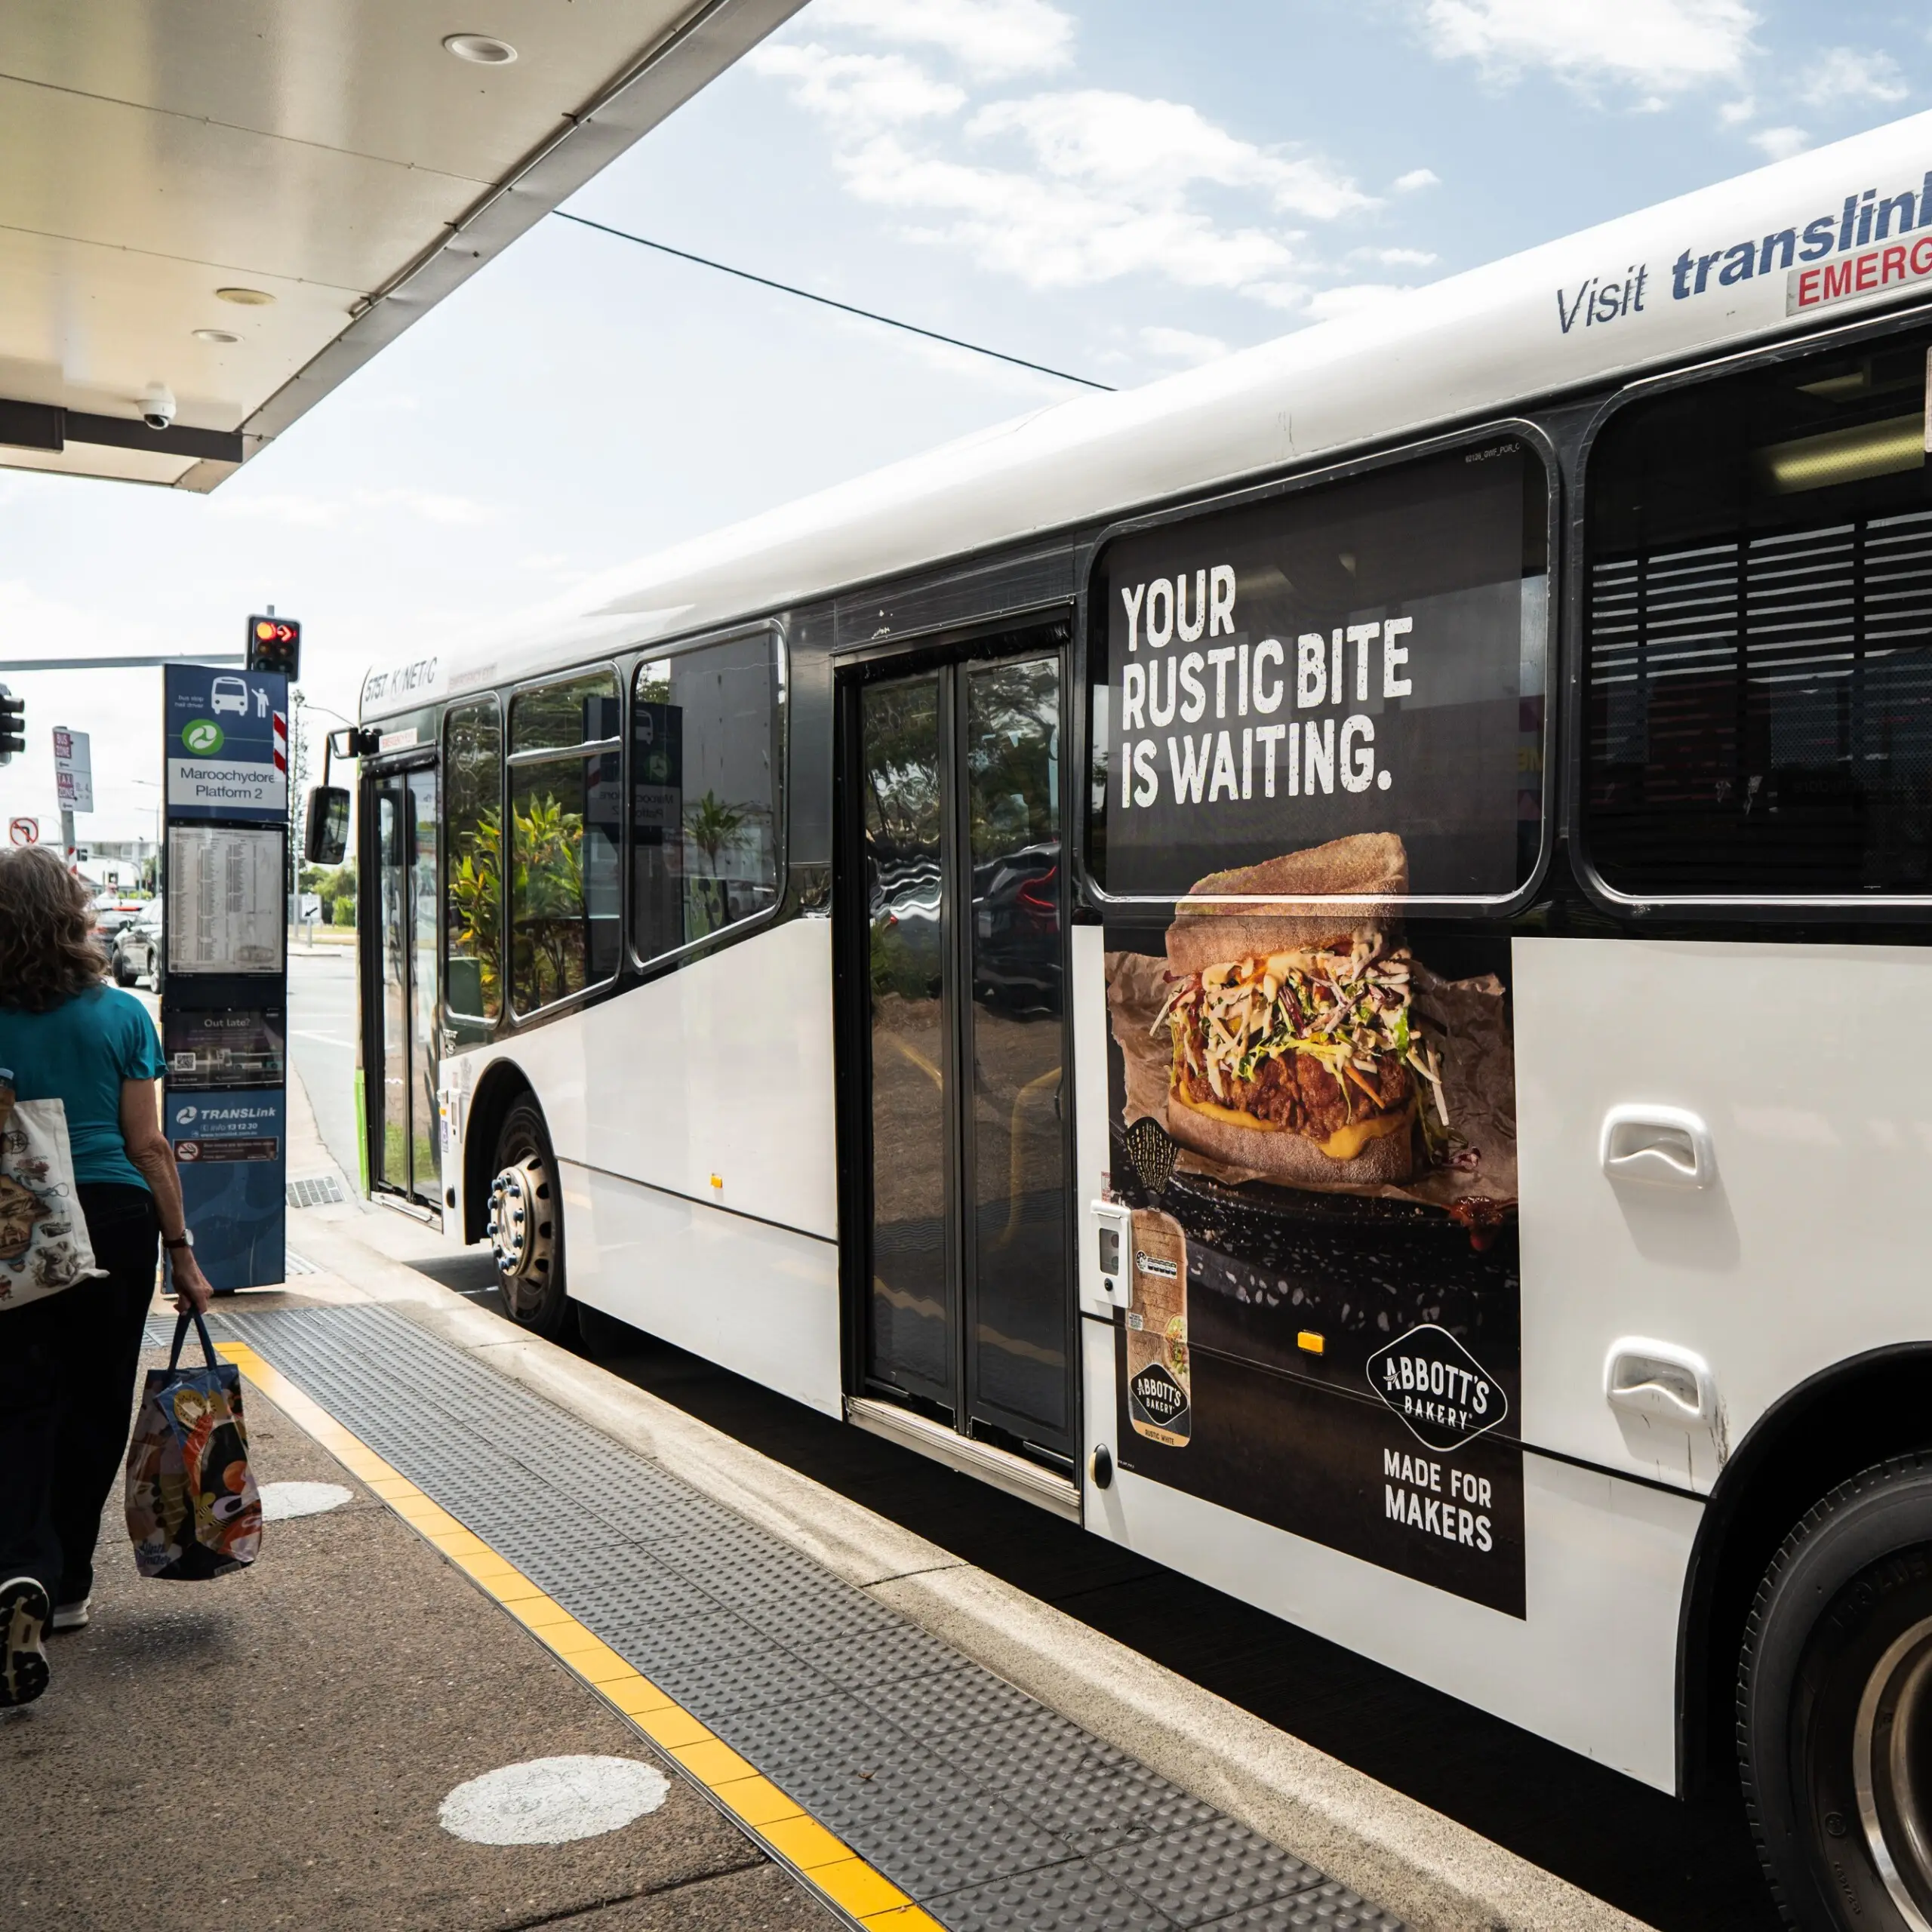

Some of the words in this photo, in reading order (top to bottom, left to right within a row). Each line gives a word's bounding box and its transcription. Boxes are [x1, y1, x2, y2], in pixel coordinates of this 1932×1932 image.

[1556, 263, 1649, 334] Visit
[1121, 564, 1237, 652] YOUR
[1122, 639, 1284, 731] RUSTIC
[1297, 616, 1414, 709] BITE
[365, 673, 389, 702] 5757
[56, 733, 68, 746] BUS
[56, 746, 70, 758] ZONE
[1121, 738, 1159, 808] IS
[1168, 714, 1392, 804] WAITING.
[57, 774, 73, 786] TAXI
[180, 767, 275, 784] Maroochydore
[58, 787, 75, 798] ZONE
[195, 785, 251, 798] Platform
[254, 788, 263, 799] 2
[204, 1019, 223, 1028] Out
[226, 1018, 251, 1027] late?
[201, 1107, 276, 1121] TRANSLink
[1137, 1378, 1182, 1407] ABBOTT'S
[1383, 1356, 1490, 1414] ABBOTT'S
[1146, 1398, 1173, 1415] BAKERY
[1145, 1429, 1160, 1440] RUSTIC
[1161, 1433, 1174, 1445] WHITE
[1384, 1448, 1441, 1493] MADE
[1451, 1469, 1492, 1509] FOR
[1385, 1484, 1493, 1552] MAKERS
